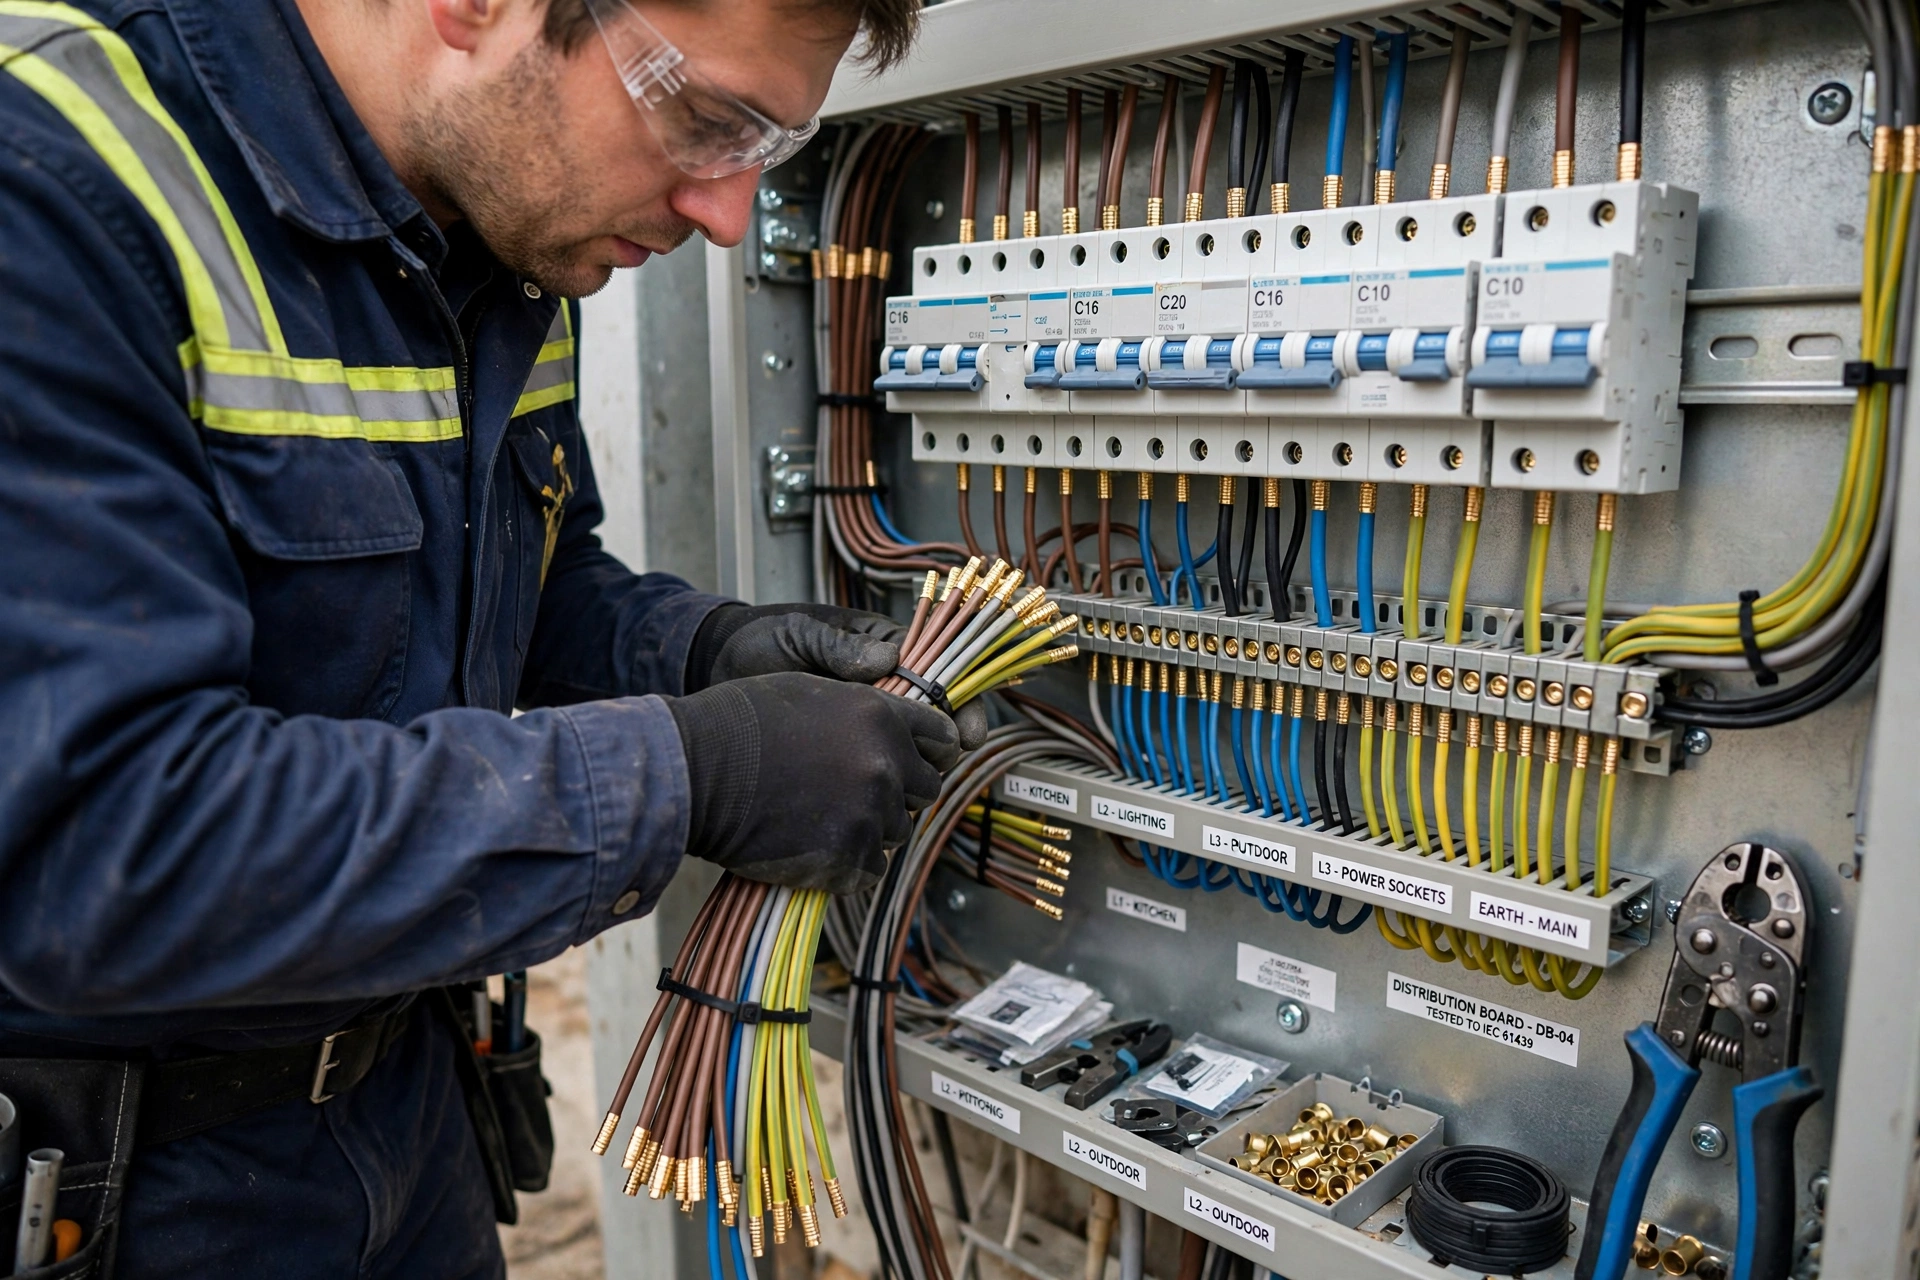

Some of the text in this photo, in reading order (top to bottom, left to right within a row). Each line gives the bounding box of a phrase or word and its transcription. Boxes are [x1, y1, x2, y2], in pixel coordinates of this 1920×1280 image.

[1254, 289, 1284, 307] C16
[1357, 283, 1391, 303] C10
[1485, 276, 1525, 297] C10
[1074, 299, 1099, 316] C16
[1159, 293, 1187, 310] C20
[888, 310, 909, 325] C16
[1008, 779, 1020, 794] L1
[1028, 785, 1070, 806] KITCHEN
[1097, 802, 1109, 817] L2
[1118, 807, 1167, 831] LIGHTING
[1209, 833, 1221, 848] L3
[1318, 859, 1332, 876] L3
[1341, 865, 1386, 891] POWER
[1387, 877, 1446, 906] SOCKETS
[1478, 900, 1524, 926] EARTH
[1538, 915, 1578, 940] MAIN
[1393, 978, 1477, 1016] DISTRIBUTION
[1479, 1005, 1525, 1031] BOARD
[1535, 1022, 1575, 1046] DB-04
[1426, 1005, 1534, 1049] TESTED TO IEC 61439
[941, 1080, 951, 1095] L2
[1068, 1138, 1081, 1156] L2
[1088, 1147, 1141, 1183] OUTDOOR
[1188, 1194, 1203, 1213] L2
[1212, 1205, 1271, 1245] OUTDOOR
